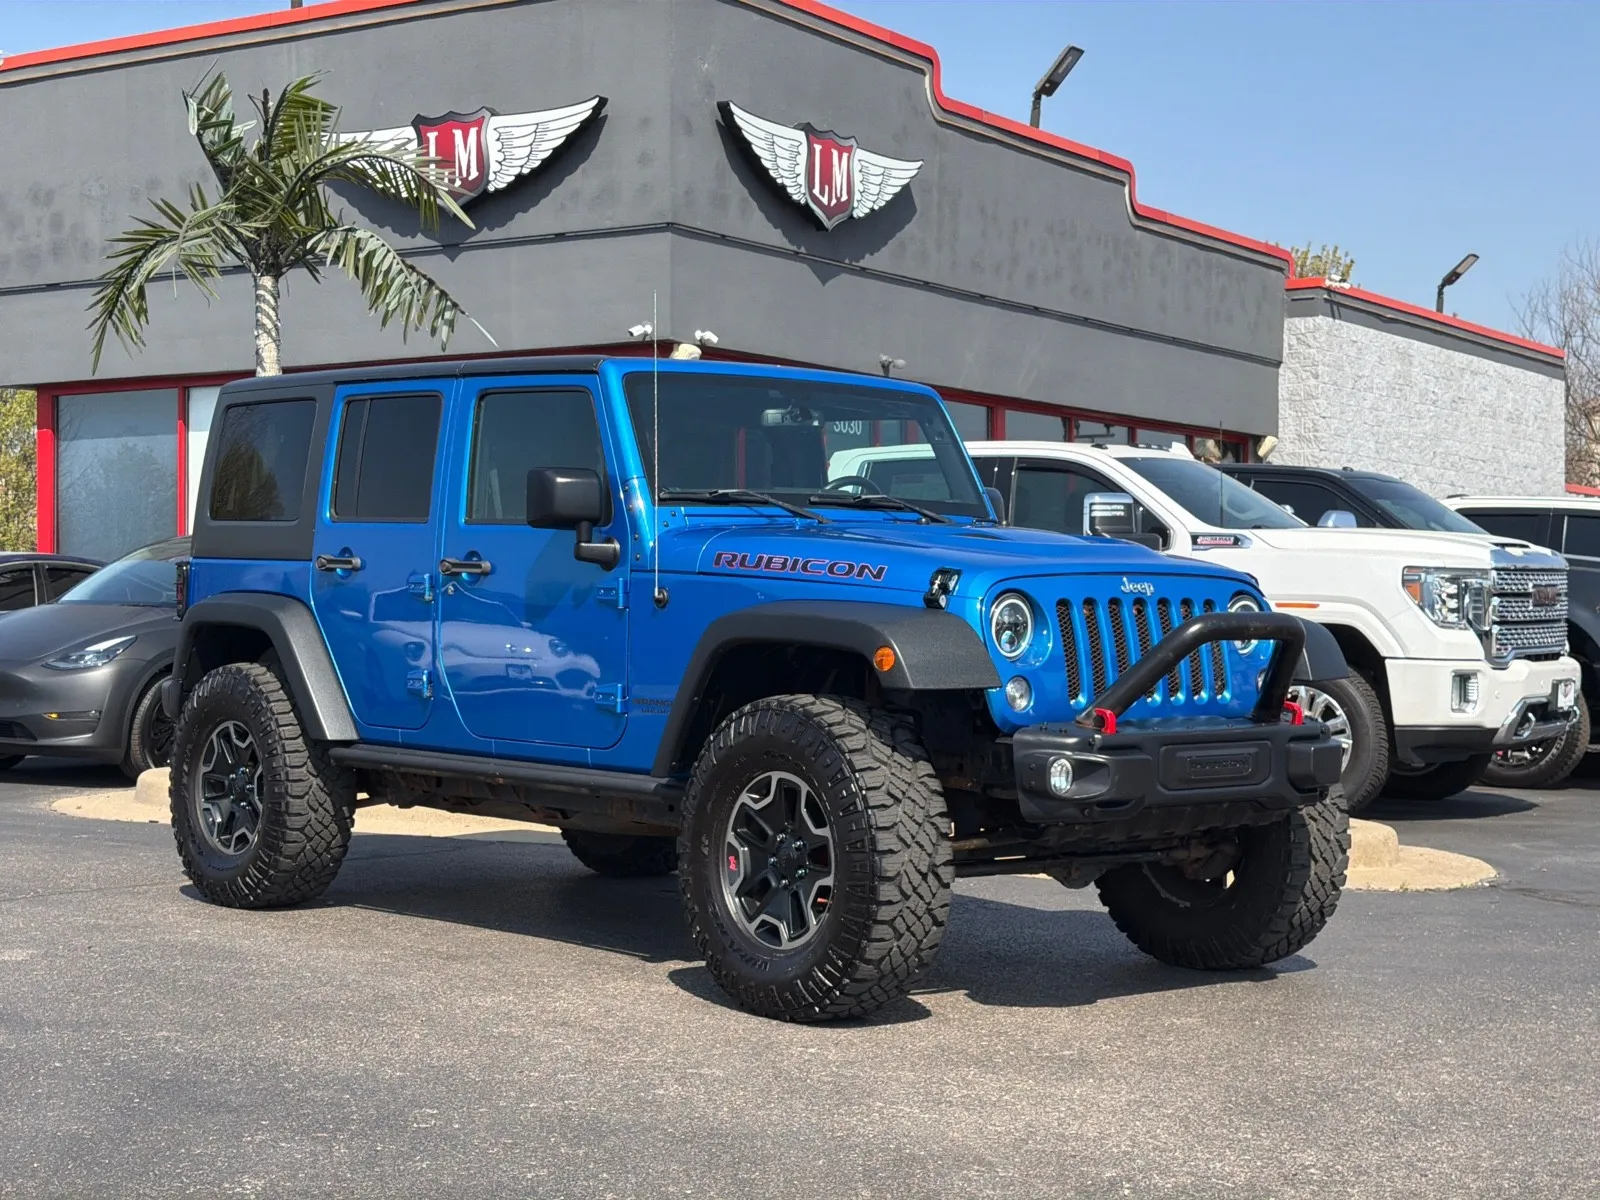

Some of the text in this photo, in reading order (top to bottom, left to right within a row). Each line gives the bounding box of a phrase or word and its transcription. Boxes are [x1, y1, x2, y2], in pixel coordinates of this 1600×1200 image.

[812, 143, 849, 207] LM
[713, 551, 888, 582] RUBICON
[1120, 576, 1155, 597] Jeep
